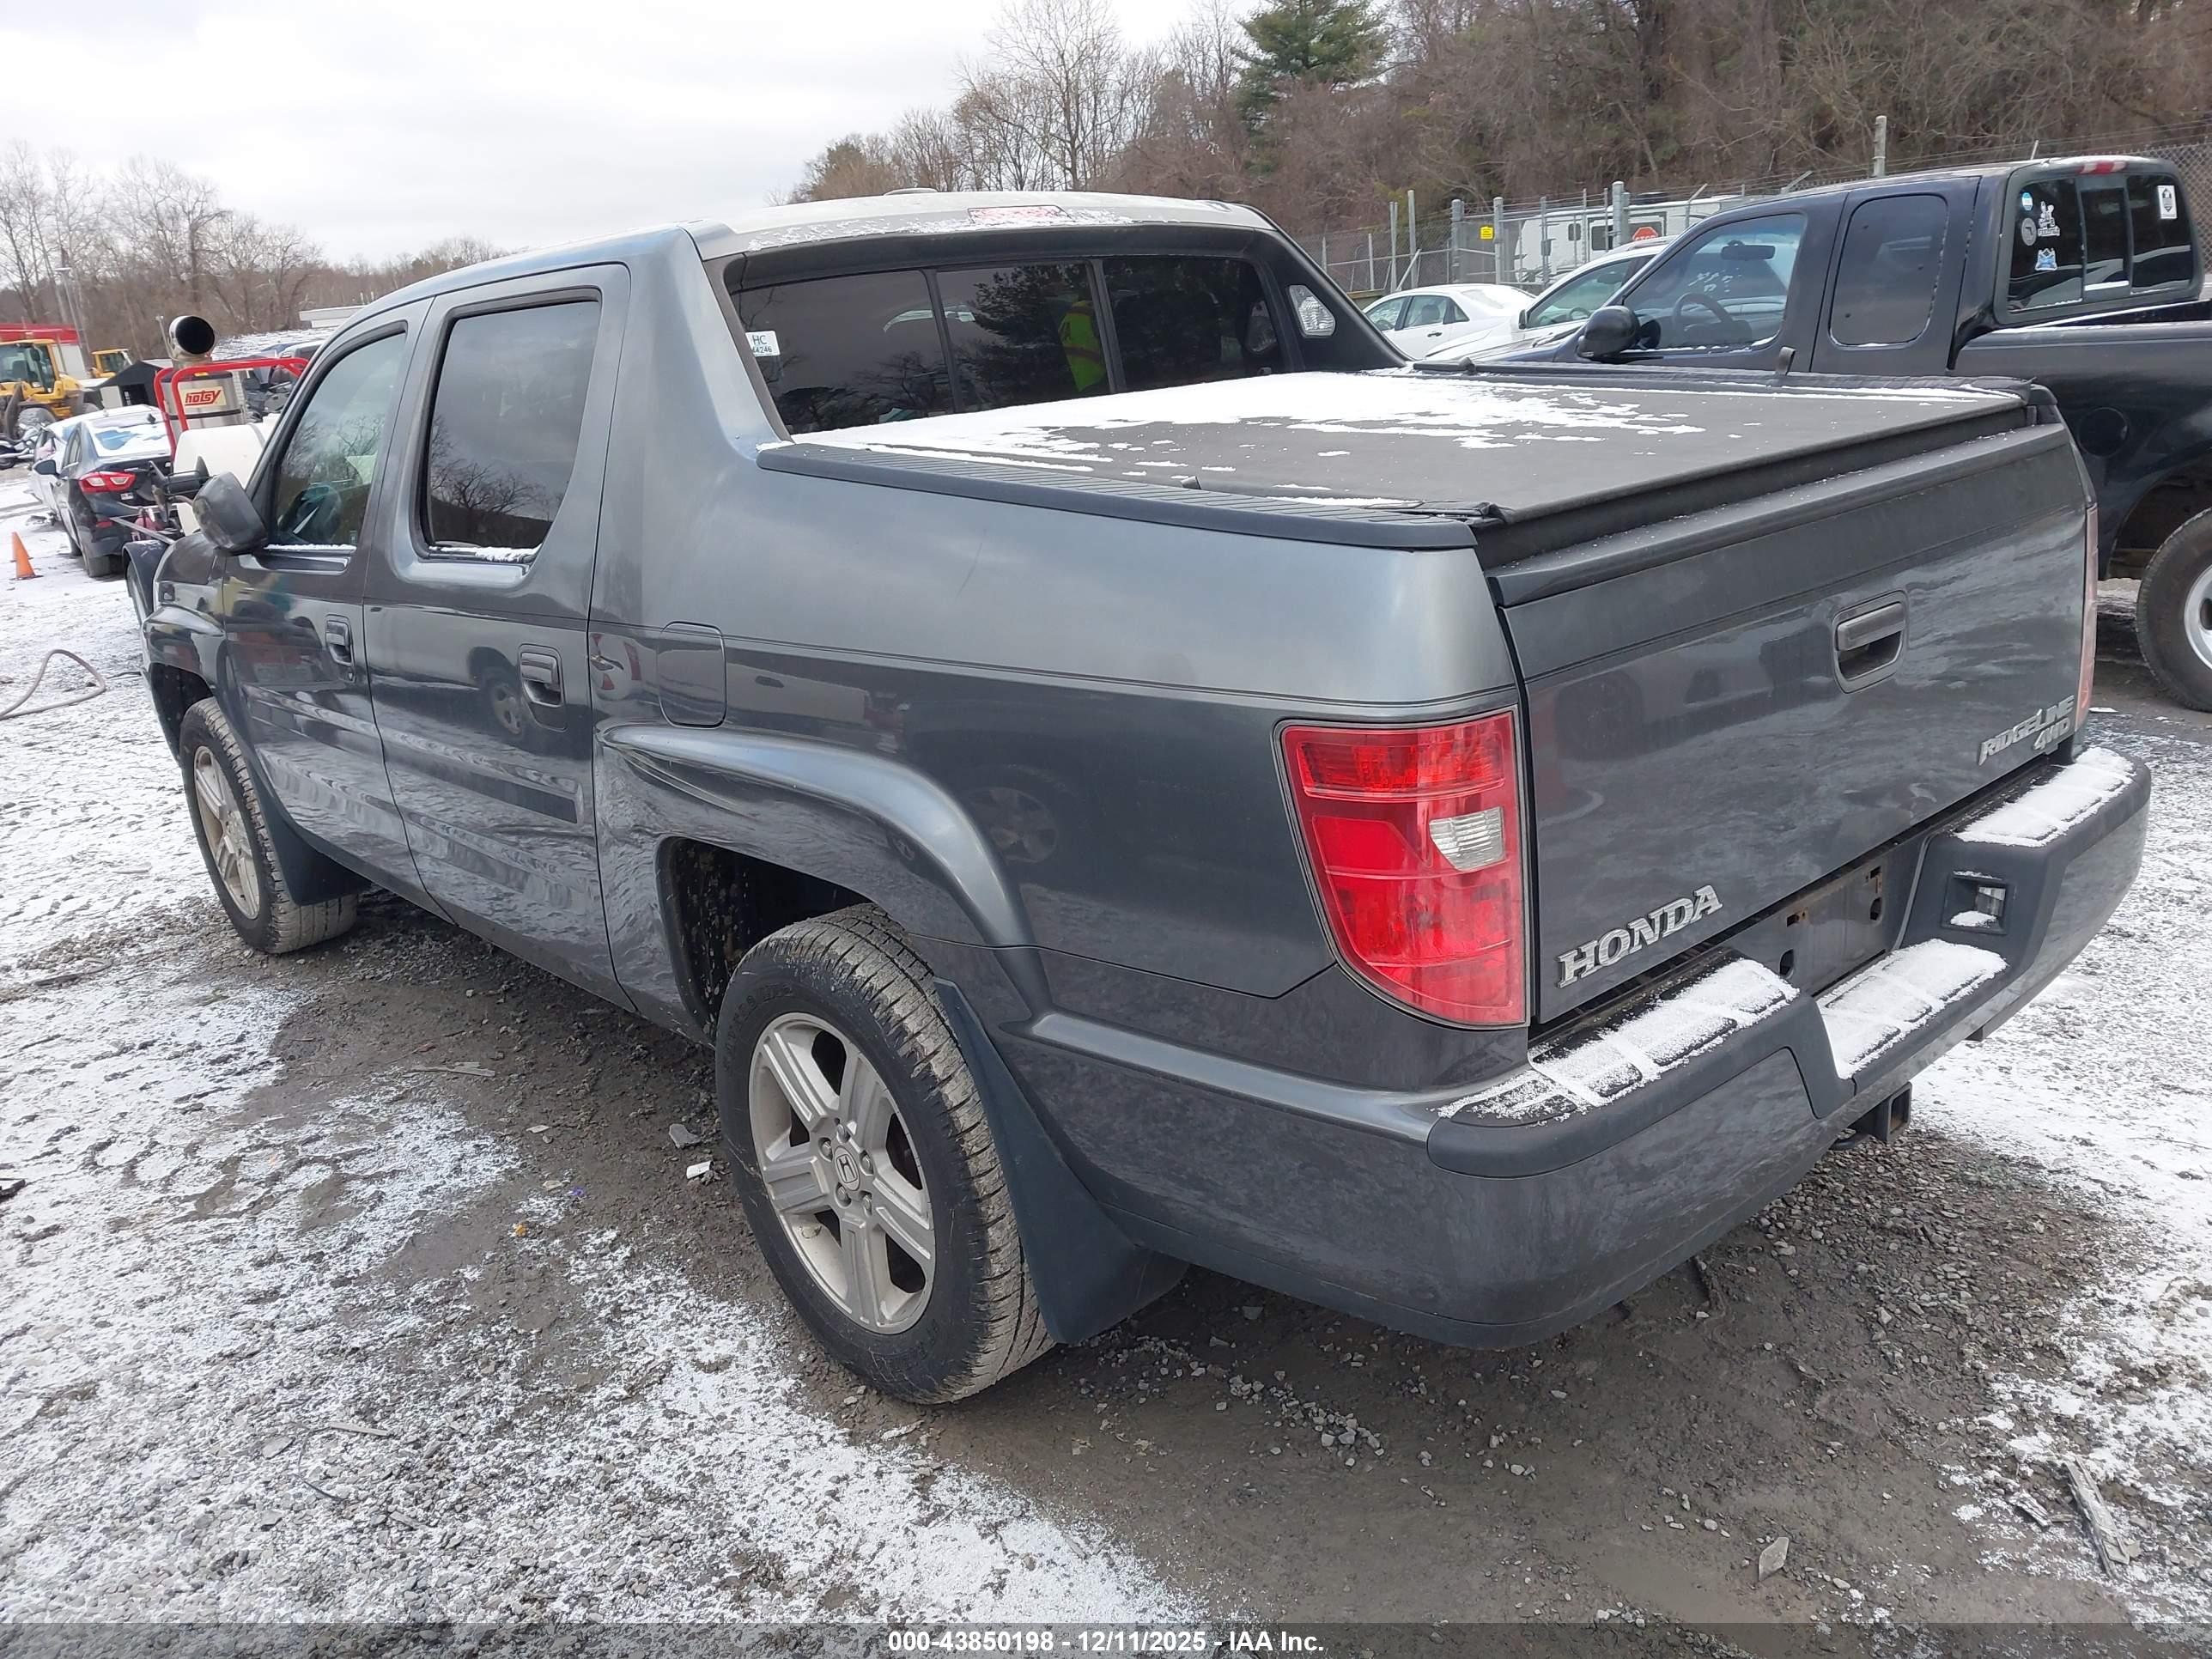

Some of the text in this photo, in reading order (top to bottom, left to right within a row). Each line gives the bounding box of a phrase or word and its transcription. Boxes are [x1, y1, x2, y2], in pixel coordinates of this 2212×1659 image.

[752, 335, 768, 345] HC
[1978, 695, 2075, 766] RIDGELINE
[2033, 716, 2071, 750] 4WD
[1556, 884, 1723, 988] HONDA
